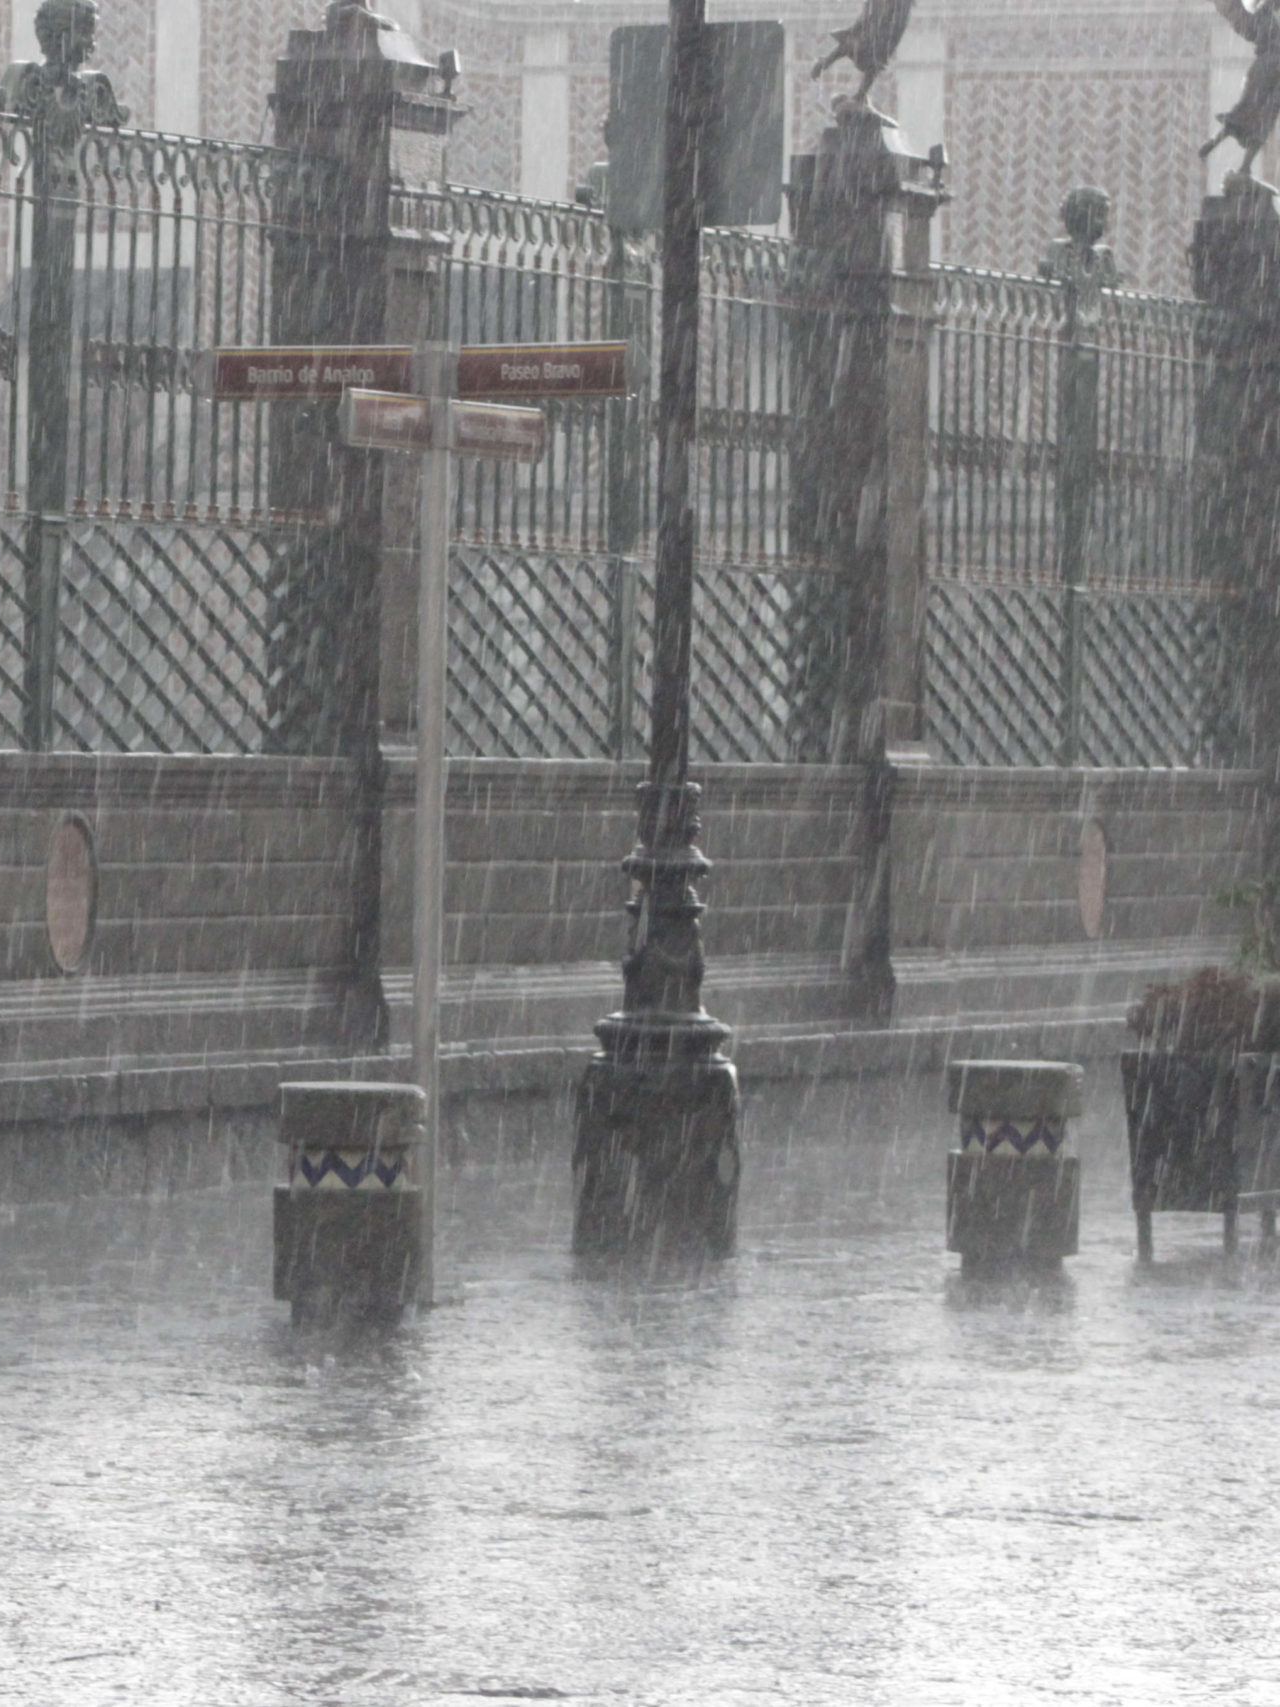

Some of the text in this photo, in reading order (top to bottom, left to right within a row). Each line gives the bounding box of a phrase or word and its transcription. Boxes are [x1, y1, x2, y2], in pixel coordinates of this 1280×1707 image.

[248, 365, 293, 383] Barrio
[298, 365, 318, 383] de
[500, 362, 580, 381] Paseo Bravo
